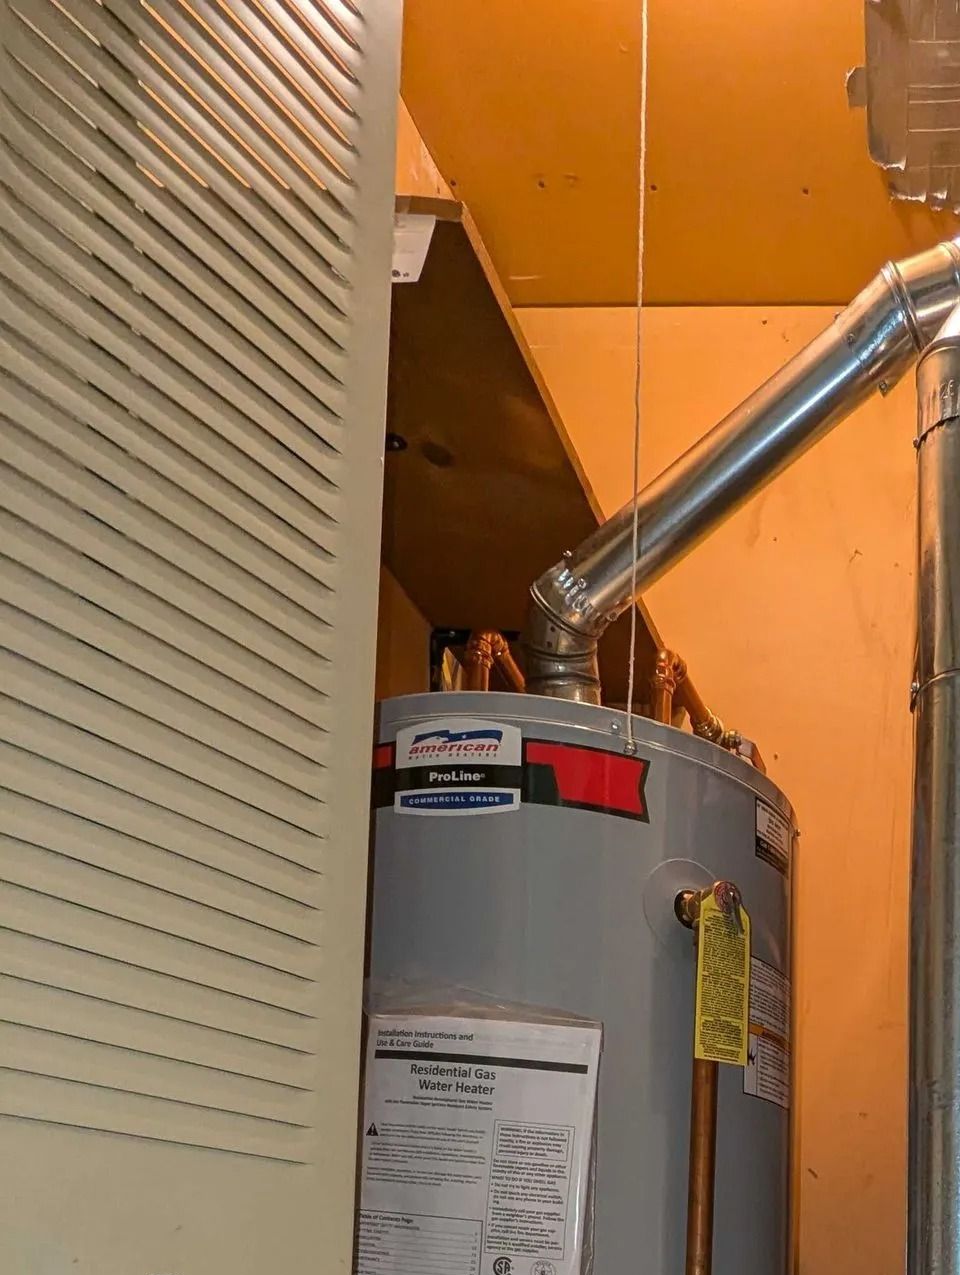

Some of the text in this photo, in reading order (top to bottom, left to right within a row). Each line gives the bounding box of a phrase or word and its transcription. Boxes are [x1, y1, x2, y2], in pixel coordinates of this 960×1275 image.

[409, 742, 499, 755] american
[409, 796, 466, 805] COMMERCIAL
[378, 1029, 474, 1041] Installation Instructions and
[376, 1039, 387, 1047] Use
[410, 1064, 497, 1080] Residential Gas
[419, 1080, 496, 1095] Water Heater
